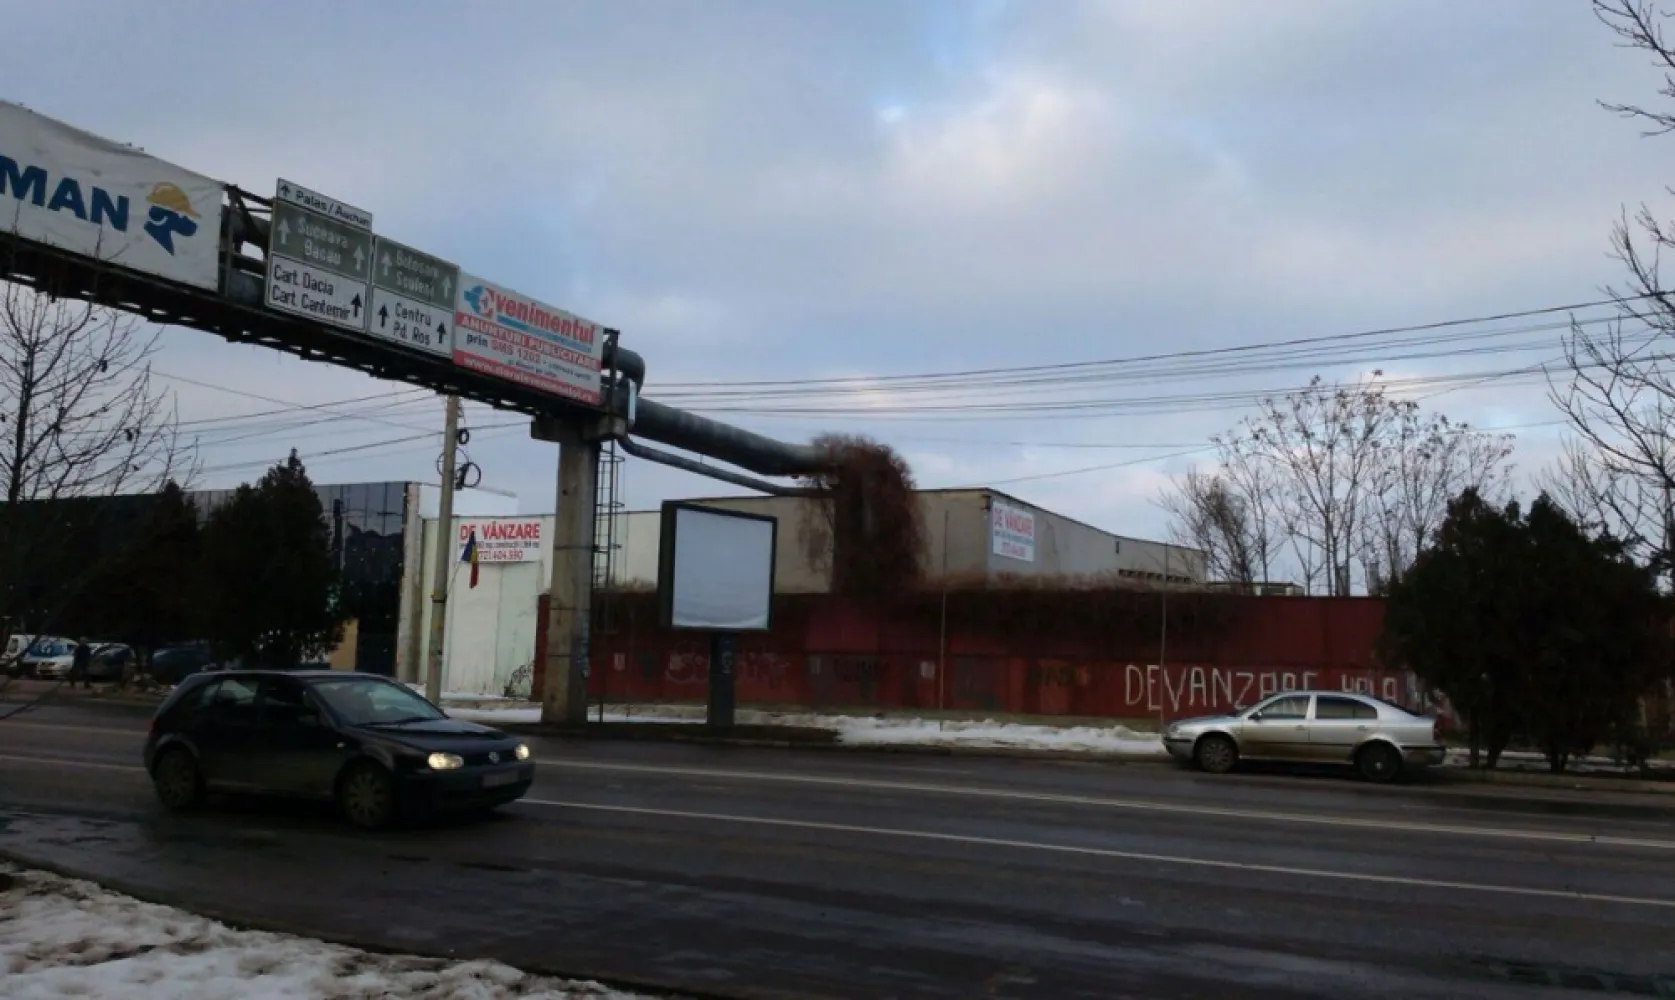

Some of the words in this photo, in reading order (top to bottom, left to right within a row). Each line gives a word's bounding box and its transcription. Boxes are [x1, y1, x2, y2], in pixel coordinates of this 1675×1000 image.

[0, 154, 130, 232] MAN
[295, 190, 328, 212] Palas
[303, 273, 334, 297] Dacia
[301, 294, 351, 321] Cantemir
[395, 302, 432, 326] Centru
[466, 333, 489, 348] prin
[491, 338, 514, 356] SMS
